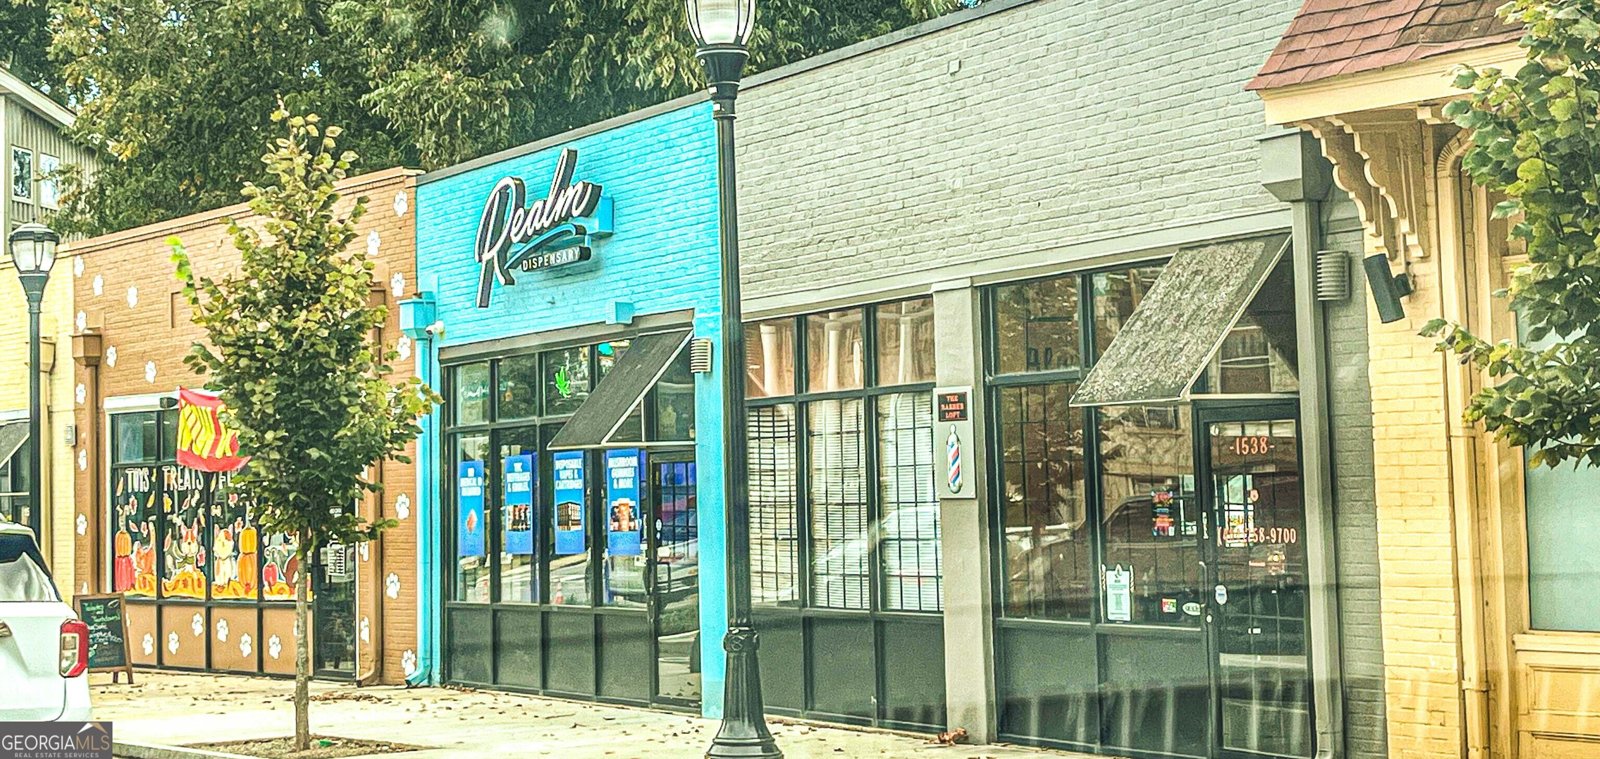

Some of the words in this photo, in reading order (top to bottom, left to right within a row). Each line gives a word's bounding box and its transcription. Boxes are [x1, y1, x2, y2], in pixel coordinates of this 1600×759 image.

[475, 147, 599, 308] Realm
[521, 248, 582, 272] DISPENSARY
[946, 394, 959, 403] THE
[945, 411, 961, 419] LOFT
